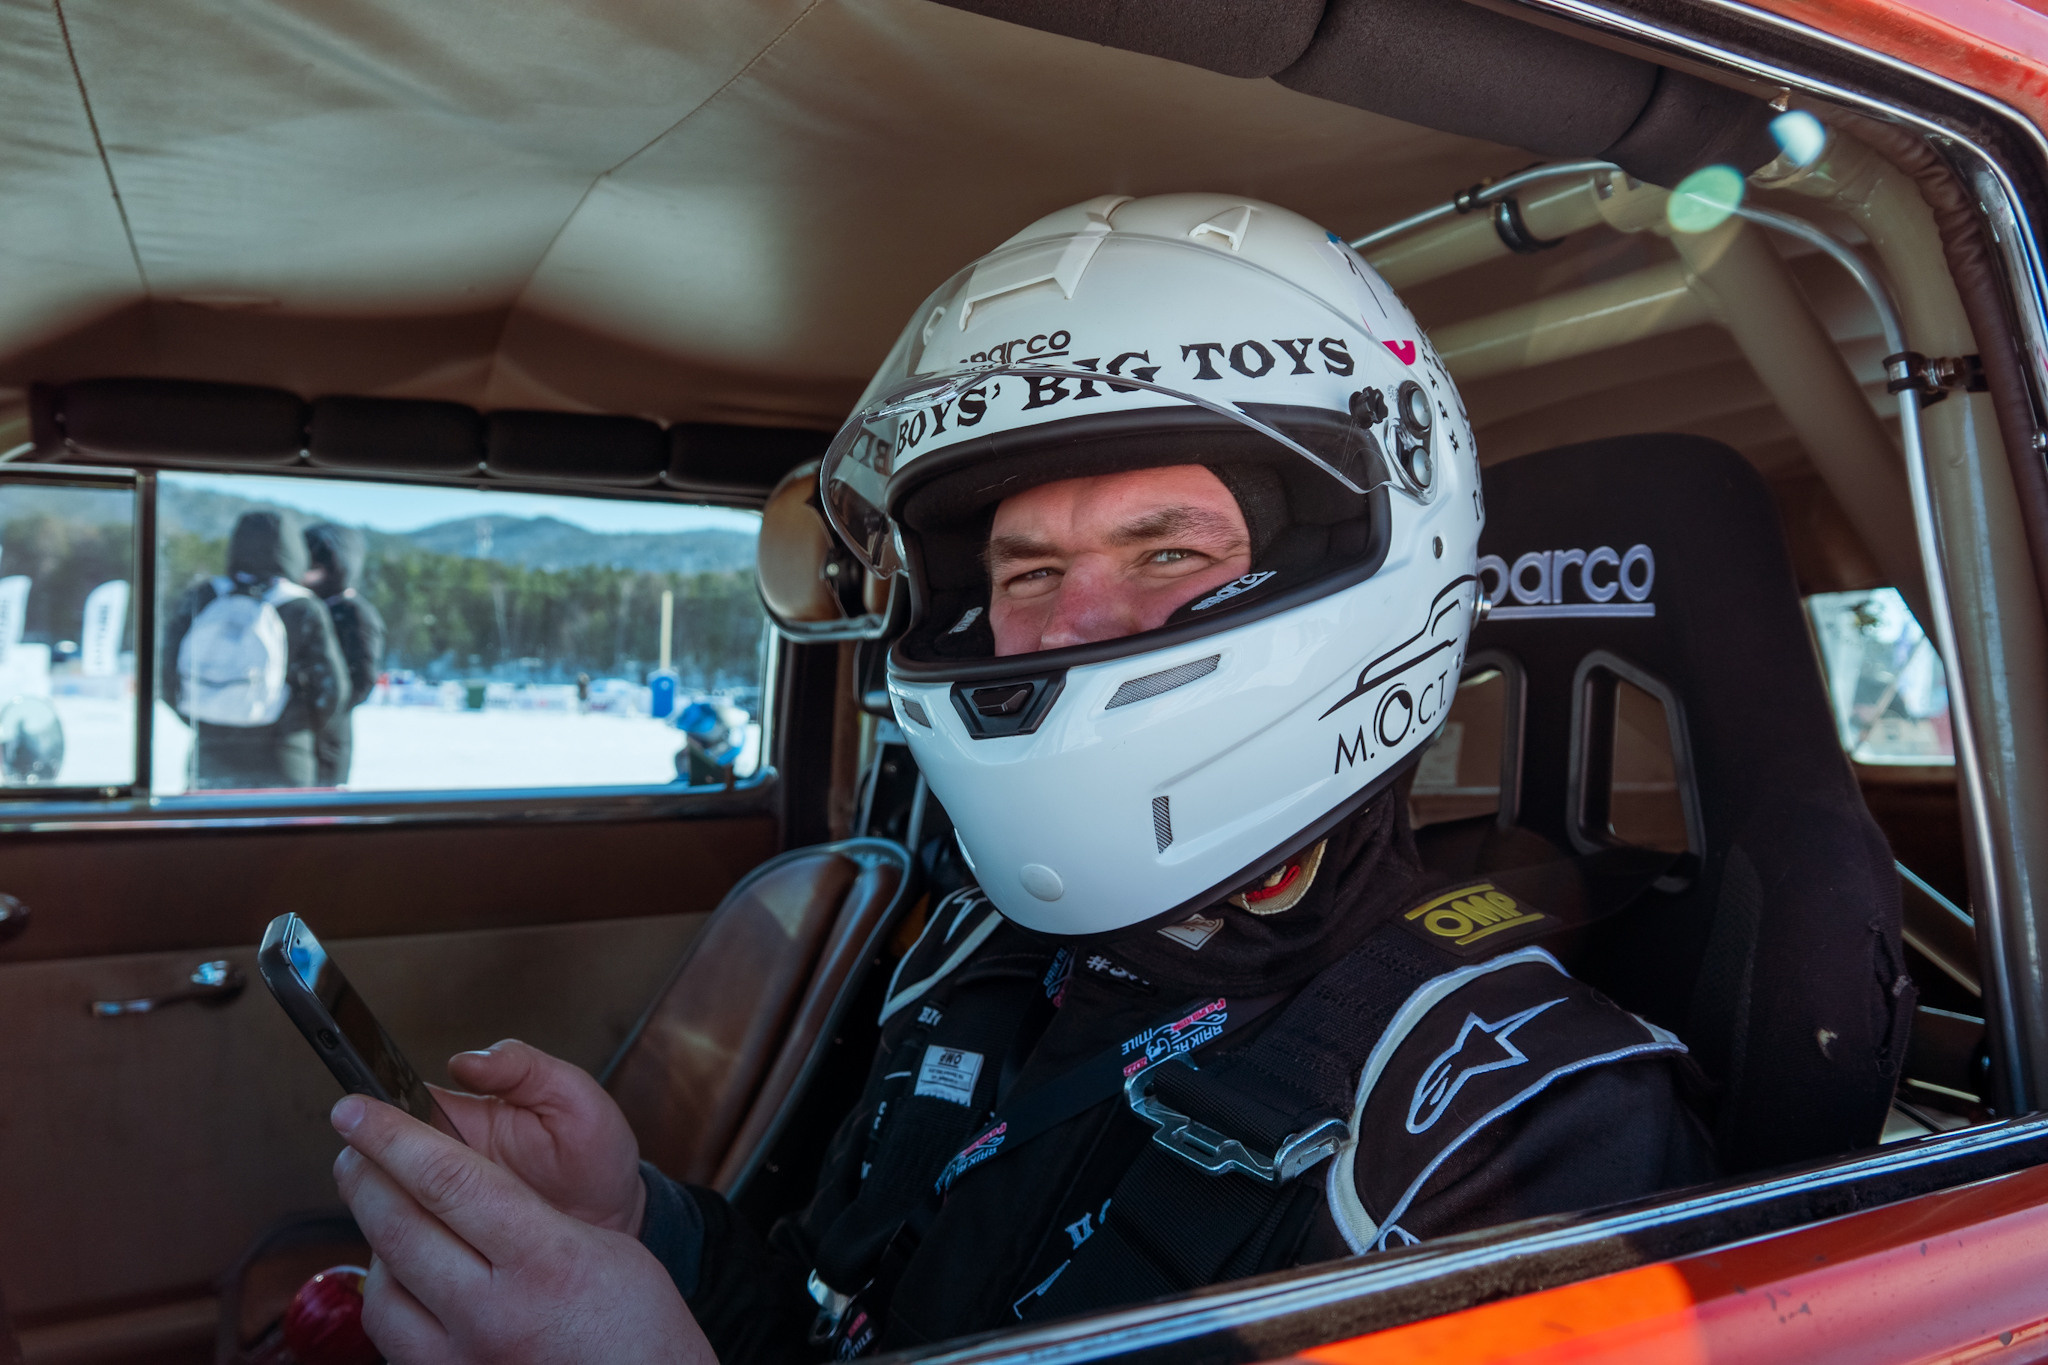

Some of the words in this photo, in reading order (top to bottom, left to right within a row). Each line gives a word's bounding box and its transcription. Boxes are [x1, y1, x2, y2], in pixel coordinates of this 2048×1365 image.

[1021, 350, 1162, 411] BIG
[1179, 336, 1355, 380] TOYS
[1477, 543, 1656, 607] parco
[1422, 888, 1526, 939] OMP
[938, 1052, 962, 1066] OMP
[1121, 1028, 1153, 1056] MILE
